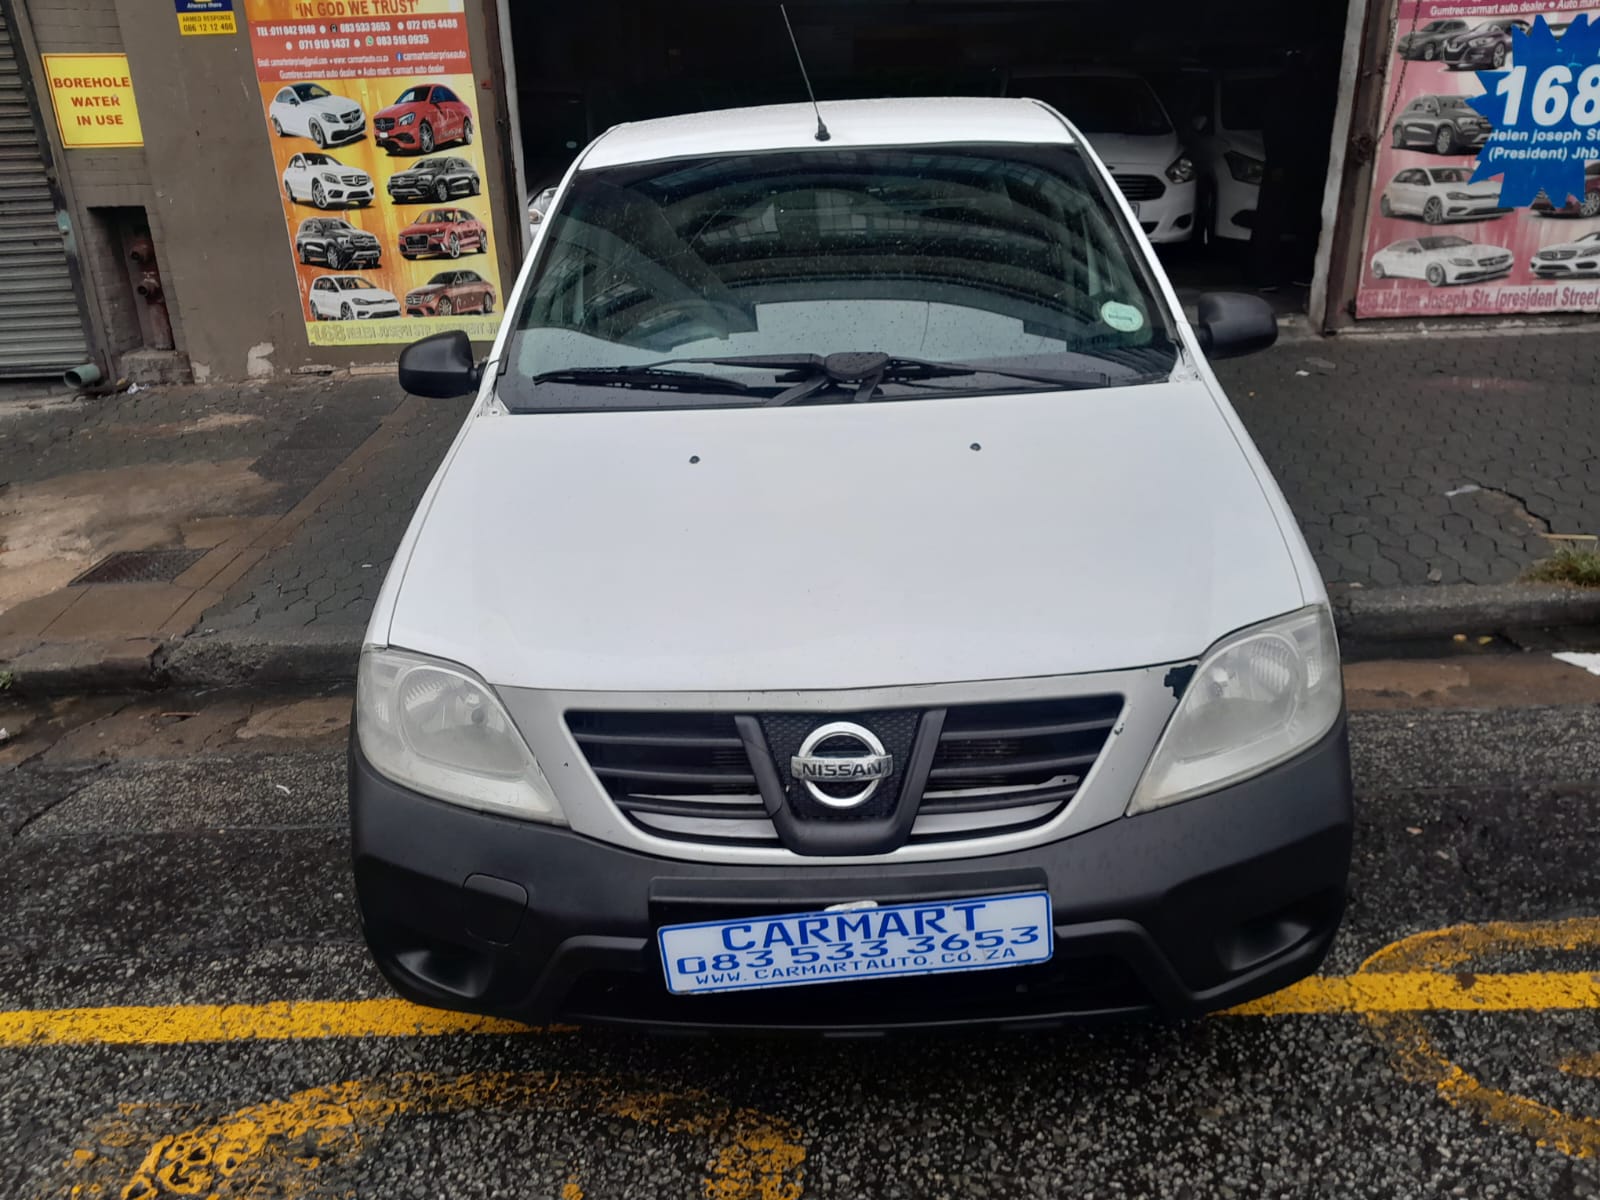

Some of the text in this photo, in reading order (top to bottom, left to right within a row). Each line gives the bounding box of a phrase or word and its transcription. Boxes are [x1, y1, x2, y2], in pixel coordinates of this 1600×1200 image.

[317, 1, 345, 16] GOD
[348, 0, 369, 15] WE
[1500, 3, 1518, 13] auto
[1520, 1, 1546, 11] dealer
[1557, 0, 1577, 9] Auto
[53, 77, 131, 89] BOREHOLE
[71, 96, 121, 108] WATER
[1496, 64, 1600, 127] 168
[76, 114, 125, 126] IN USE
[1488, 128, 1530, 142] Helen
[1530, 128, 1582, 144] joseph
[1488, 146, 1599, 163] (President) Jhb
[802, 762, 882, 777] NISSAN
[721, 904, 986, 951] CARMART
[677, 925, 1040, 975] 083 533 3653
